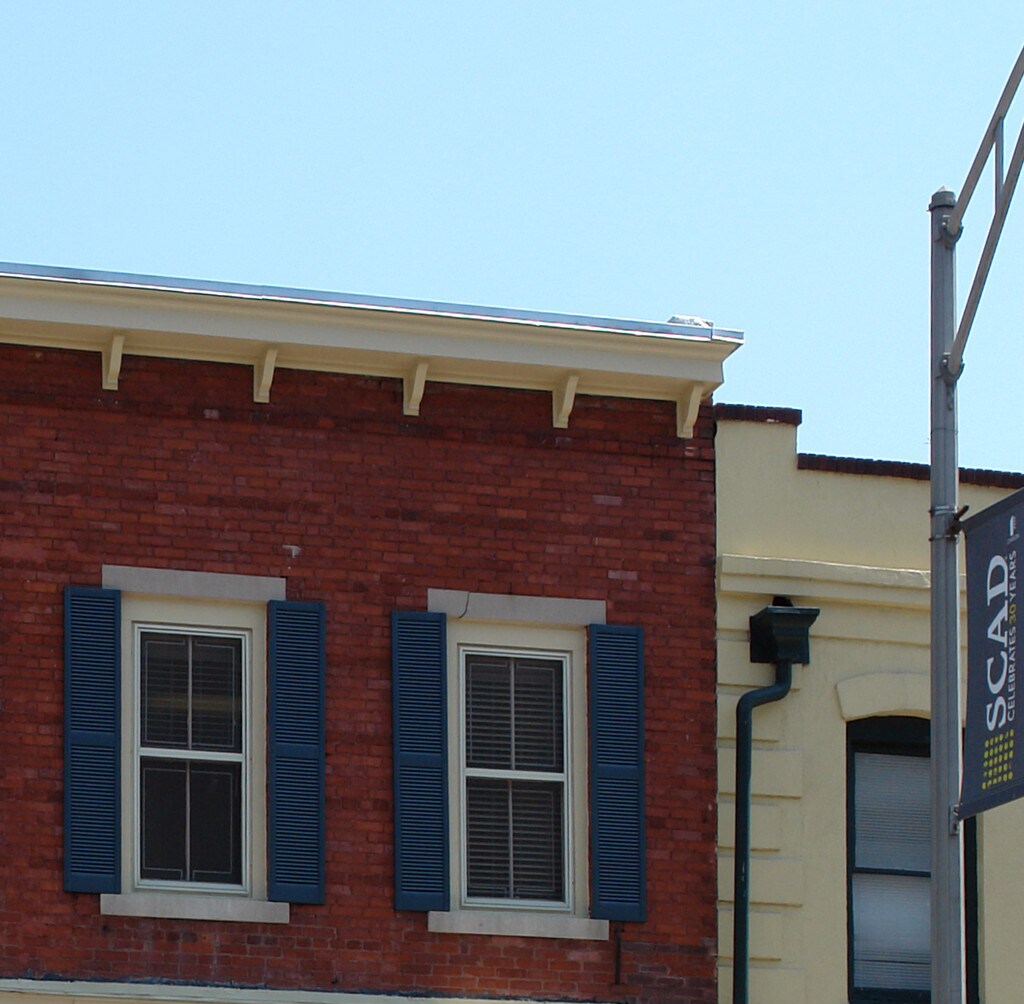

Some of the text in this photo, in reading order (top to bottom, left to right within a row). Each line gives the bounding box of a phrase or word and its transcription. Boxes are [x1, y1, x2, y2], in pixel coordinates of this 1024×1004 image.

[987, 554, 1009, 731] SCAD
[1008, 550, 1017, 722] CELEBRATES 30 YEARS
